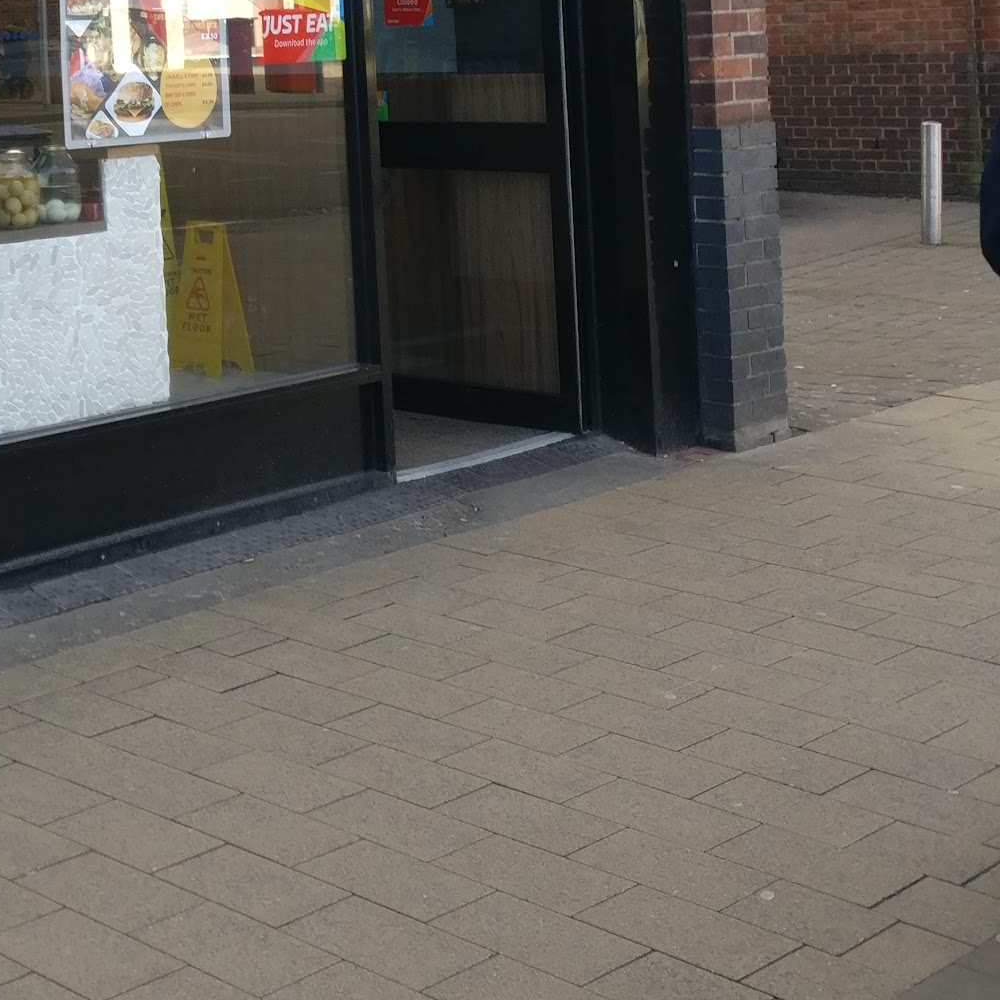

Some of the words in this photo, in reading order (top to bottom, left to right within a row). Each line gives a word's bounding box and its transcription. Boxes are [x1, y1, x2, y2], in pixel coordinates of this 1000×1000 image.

[263, 13, 303, 39] JUST
[274, 38, 305, 48] Download
[305, 37, 316, 46] the
[317, 39, 329, 47] app
[188, 311, 207, 321] WET
